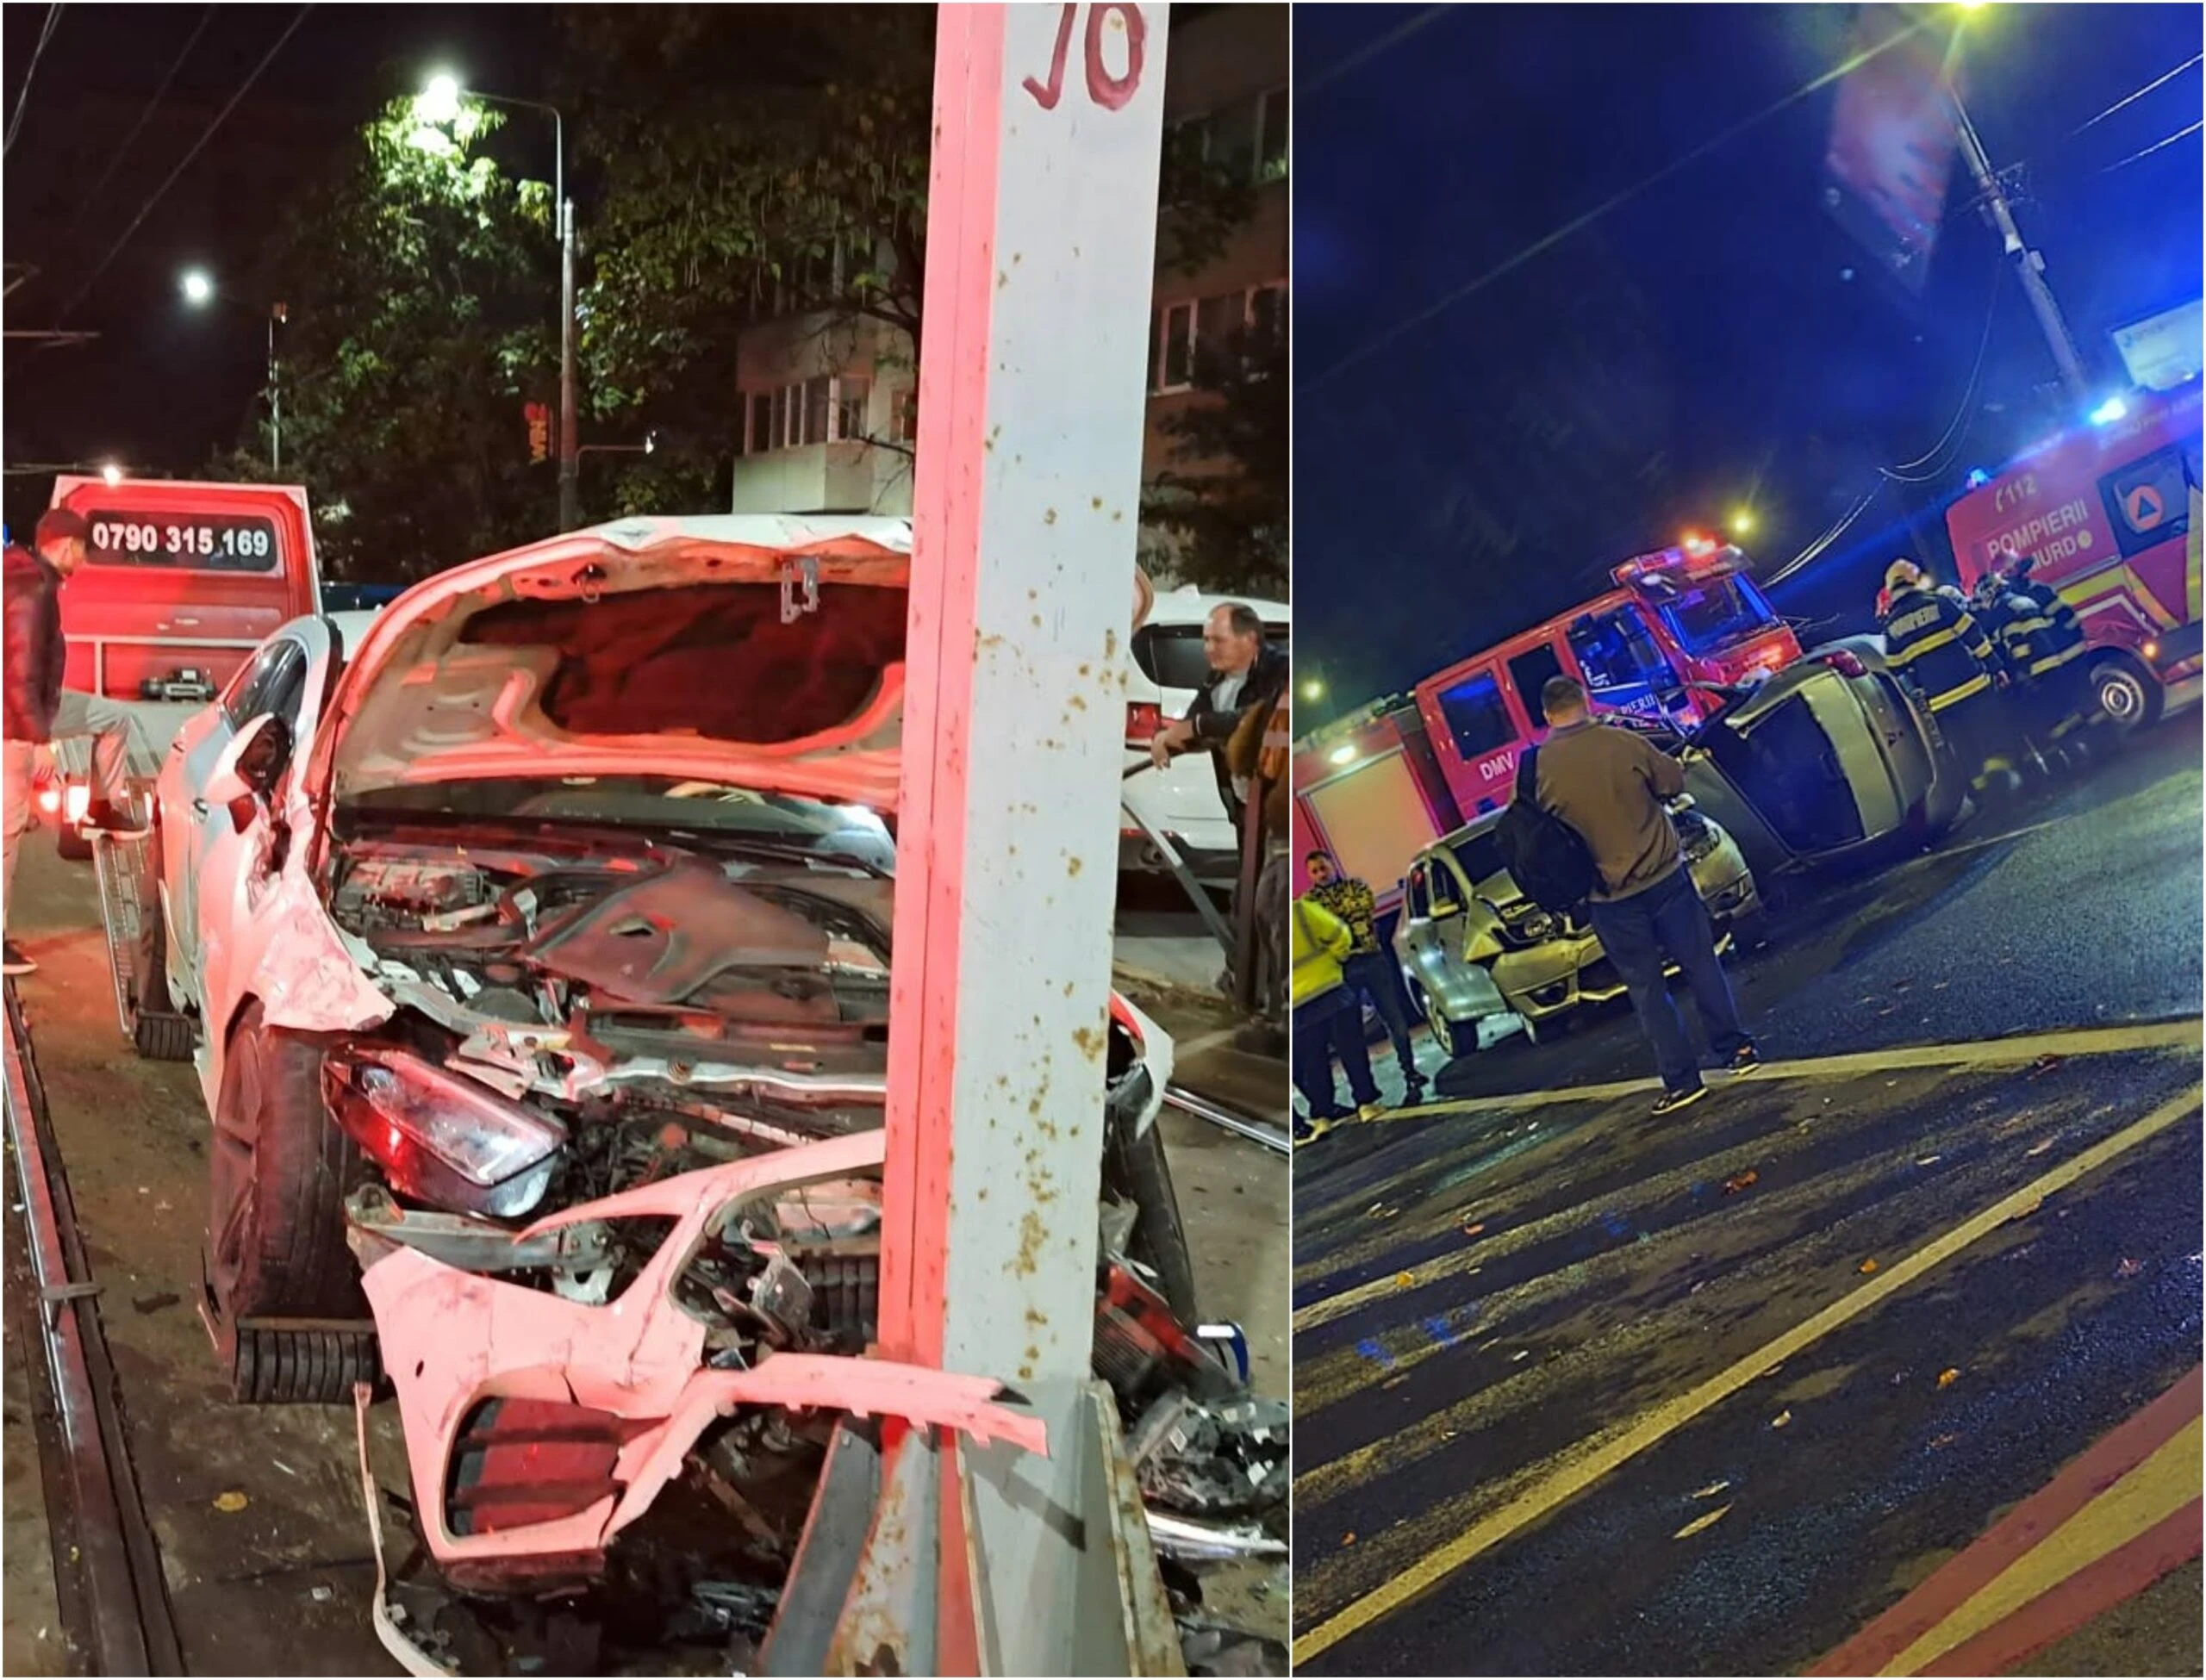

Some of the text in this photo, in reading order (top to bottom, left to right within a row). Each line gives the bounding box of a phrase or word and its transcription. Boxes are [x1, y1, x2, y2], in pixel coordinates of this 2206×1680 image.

[2005, 474, 2036, 504] 112
[92, 522, 269, 557] 0790 315 169
[1987, 498, 2089, 559] POMPIERII
[1479, 751, 1515, 781] DMV
